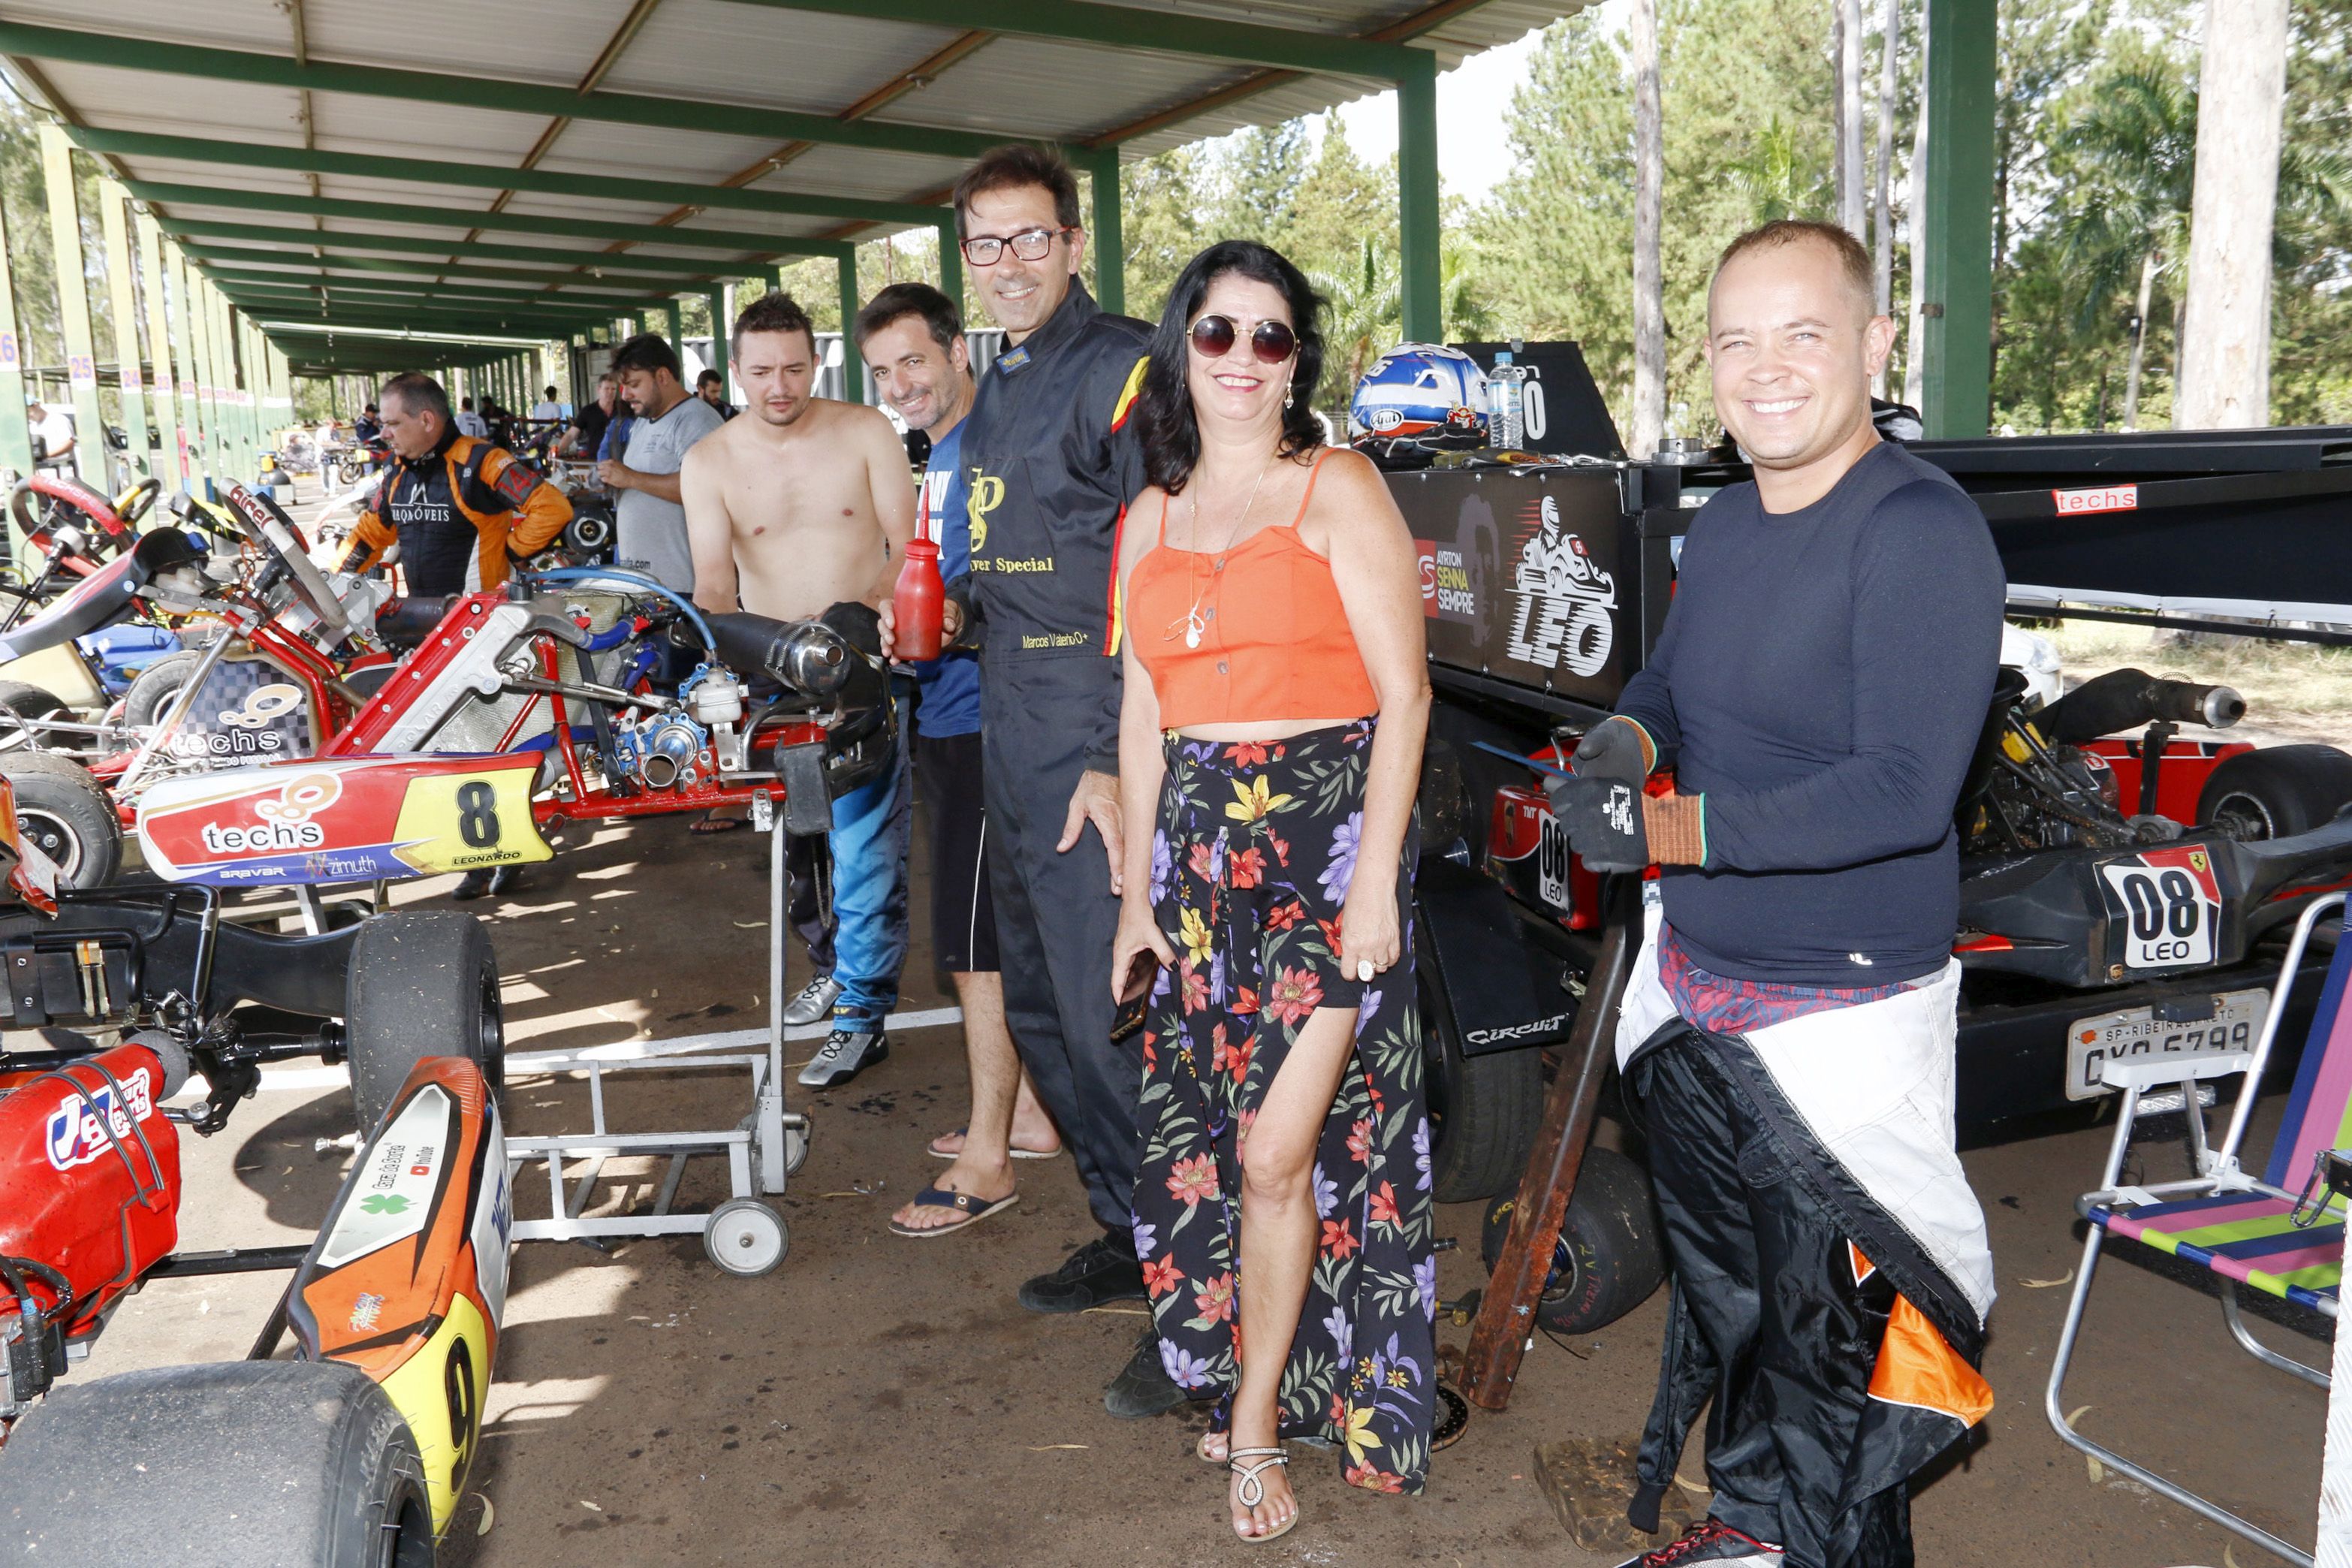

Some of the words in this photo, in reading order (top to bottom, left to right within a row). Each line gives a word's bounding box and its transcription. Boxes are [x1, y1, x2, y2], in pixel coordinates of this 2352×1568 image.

[0, 334, 15, 362] 6
[71, 356, 92, 378] 25
[122, 369, 140, 387] 24
[230, 484, 275, 529] birel
[2059, 491, 2135, 510] techs
[996, 556, 1054, 574] Special
[1437, 550, 1461, 567] AYRTON
[1437, 568, 1470, 591] SENNA
[1437, 588, 1475, 615] SEMPRE
[1022, 635, 1049, 649] Marcos
[1506, 595, 1614, 677] LEO
[173, 728, 282, 755] techs
[456, 779, 502, 849] 8
[205, 822, 321, 849] techs
[453, 851, 521, 864] LEONARDO
[1542, 819, 1565, 884] 08
[1545, 881, 1562, 902] LEO
[2123, 870, 2199, 941] 08
[2142, 941, 2191, 962] LEO
